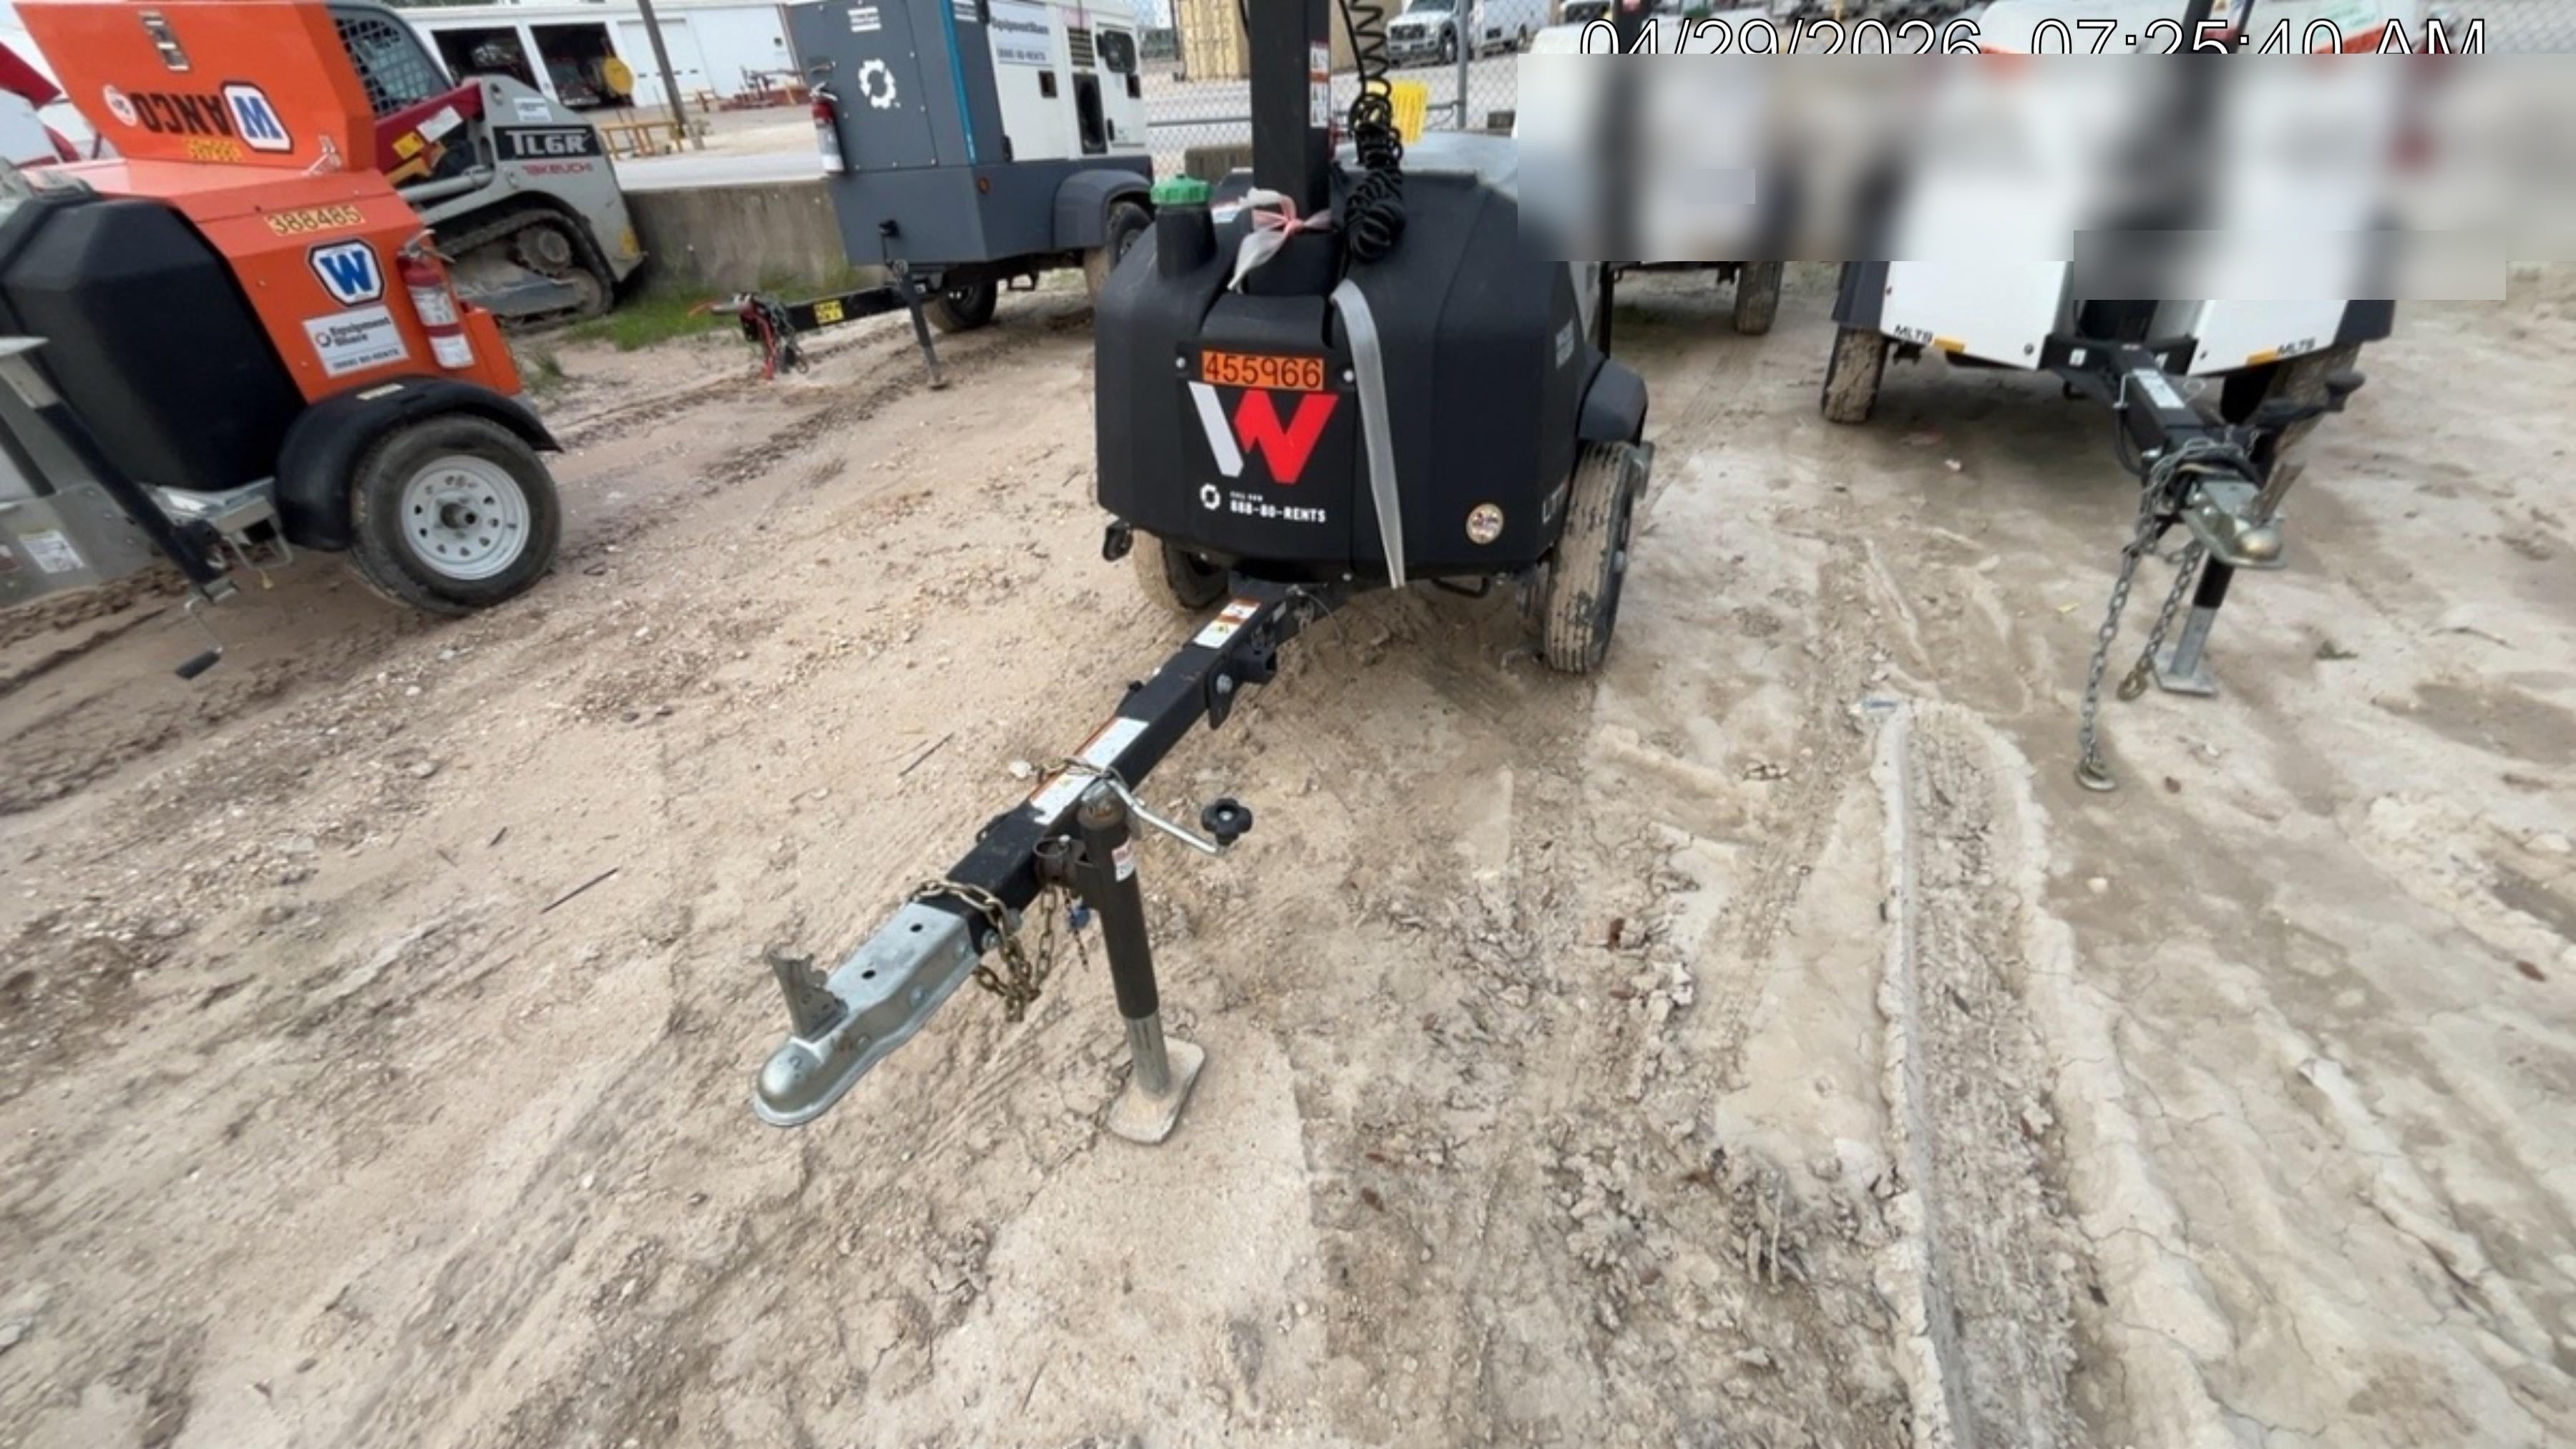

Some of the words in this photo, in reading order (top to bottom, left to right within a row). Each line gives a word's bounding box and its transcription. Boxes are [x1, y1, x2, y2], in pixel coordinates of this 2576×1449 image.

[505, 128, 592, 155] TL6R
[268, 205, 362, 235] 388485
[319, 250, 373, 296] W
[1205, 353, 1321, 389] 455966
[1229, 499, 1327, 523] 888-80-RENTS
